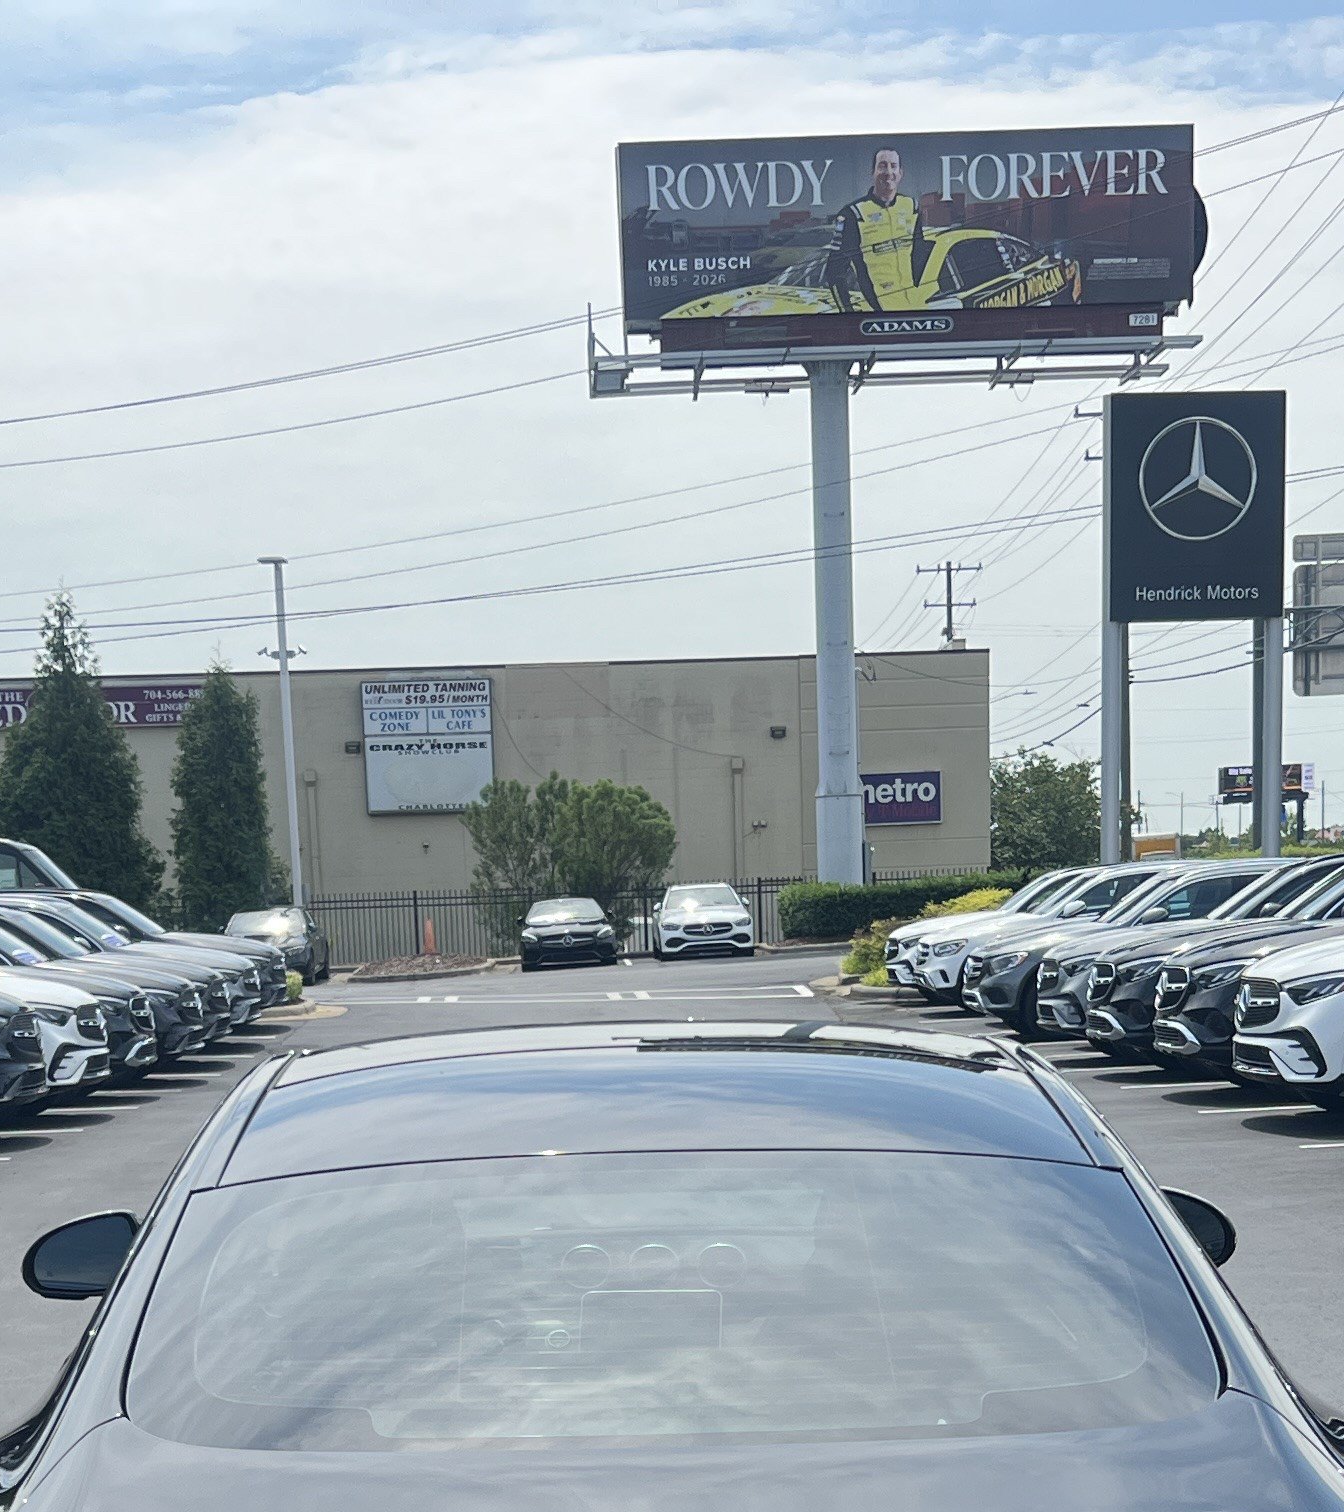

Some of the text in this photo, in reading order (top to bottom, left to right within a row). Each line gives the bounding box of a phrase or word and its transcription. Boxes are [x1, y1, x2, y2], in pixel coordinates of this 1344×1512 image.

[645, 149, 1169, 211] ROWDY FOREVER
[647, 256, 751, 272] KYLE BUSCH
[648, 275, 678, 287] 1985
[692, 274, 727, 286] 2026
[868, 320, 946, 333] ADAMS
[1136, 584, 1259, 601] Hendrick Motors
[364, 681, 486, 695] UNLIMITED TANNING
[146, 713, 174, 722] GIFTS
[369, 711, 420, 721] COMEDY
[431, 708, 487, 720] LIL TONY'S
[380, 722, 411, 732] ZONE
[446, 720, 473, 731] CAFE
[369, 741, 488, 752] CRAZY HORSE
[398, 803, 464, 811] CHARLOTTE
